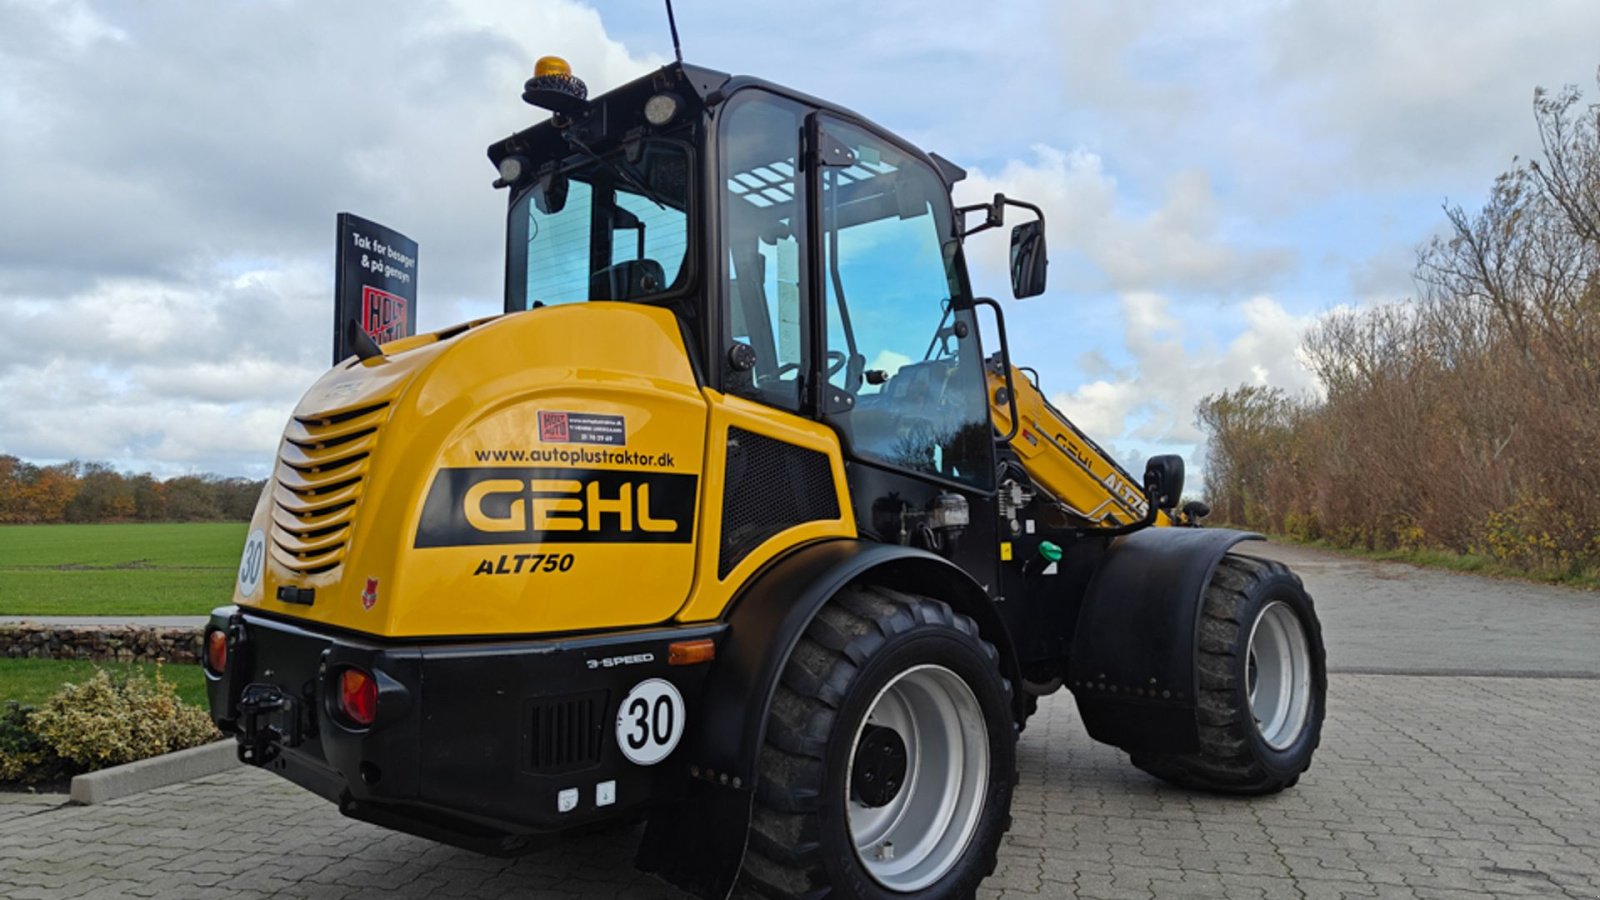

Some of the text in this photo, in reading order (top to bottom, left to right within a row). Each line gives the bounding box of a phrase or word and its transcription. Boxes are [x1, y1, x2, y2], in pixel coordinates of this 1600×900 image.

[353, 232, 371, 251] Tak
[373, 239, 386, 255] for
[361, 254, 410, 283] & på gensyn
[370, 293, 402, 331] HOLT
[475, 447, 675, 467] www.autoplustraktor.dk
[464, 479, 678, 532] GEHL
[241, 540, 263, 585] 30
[473, 553, 575, 576] ALT750
[586, 653, 655, 669] 3-SPEED
[627, 694, 675, 750] 30
